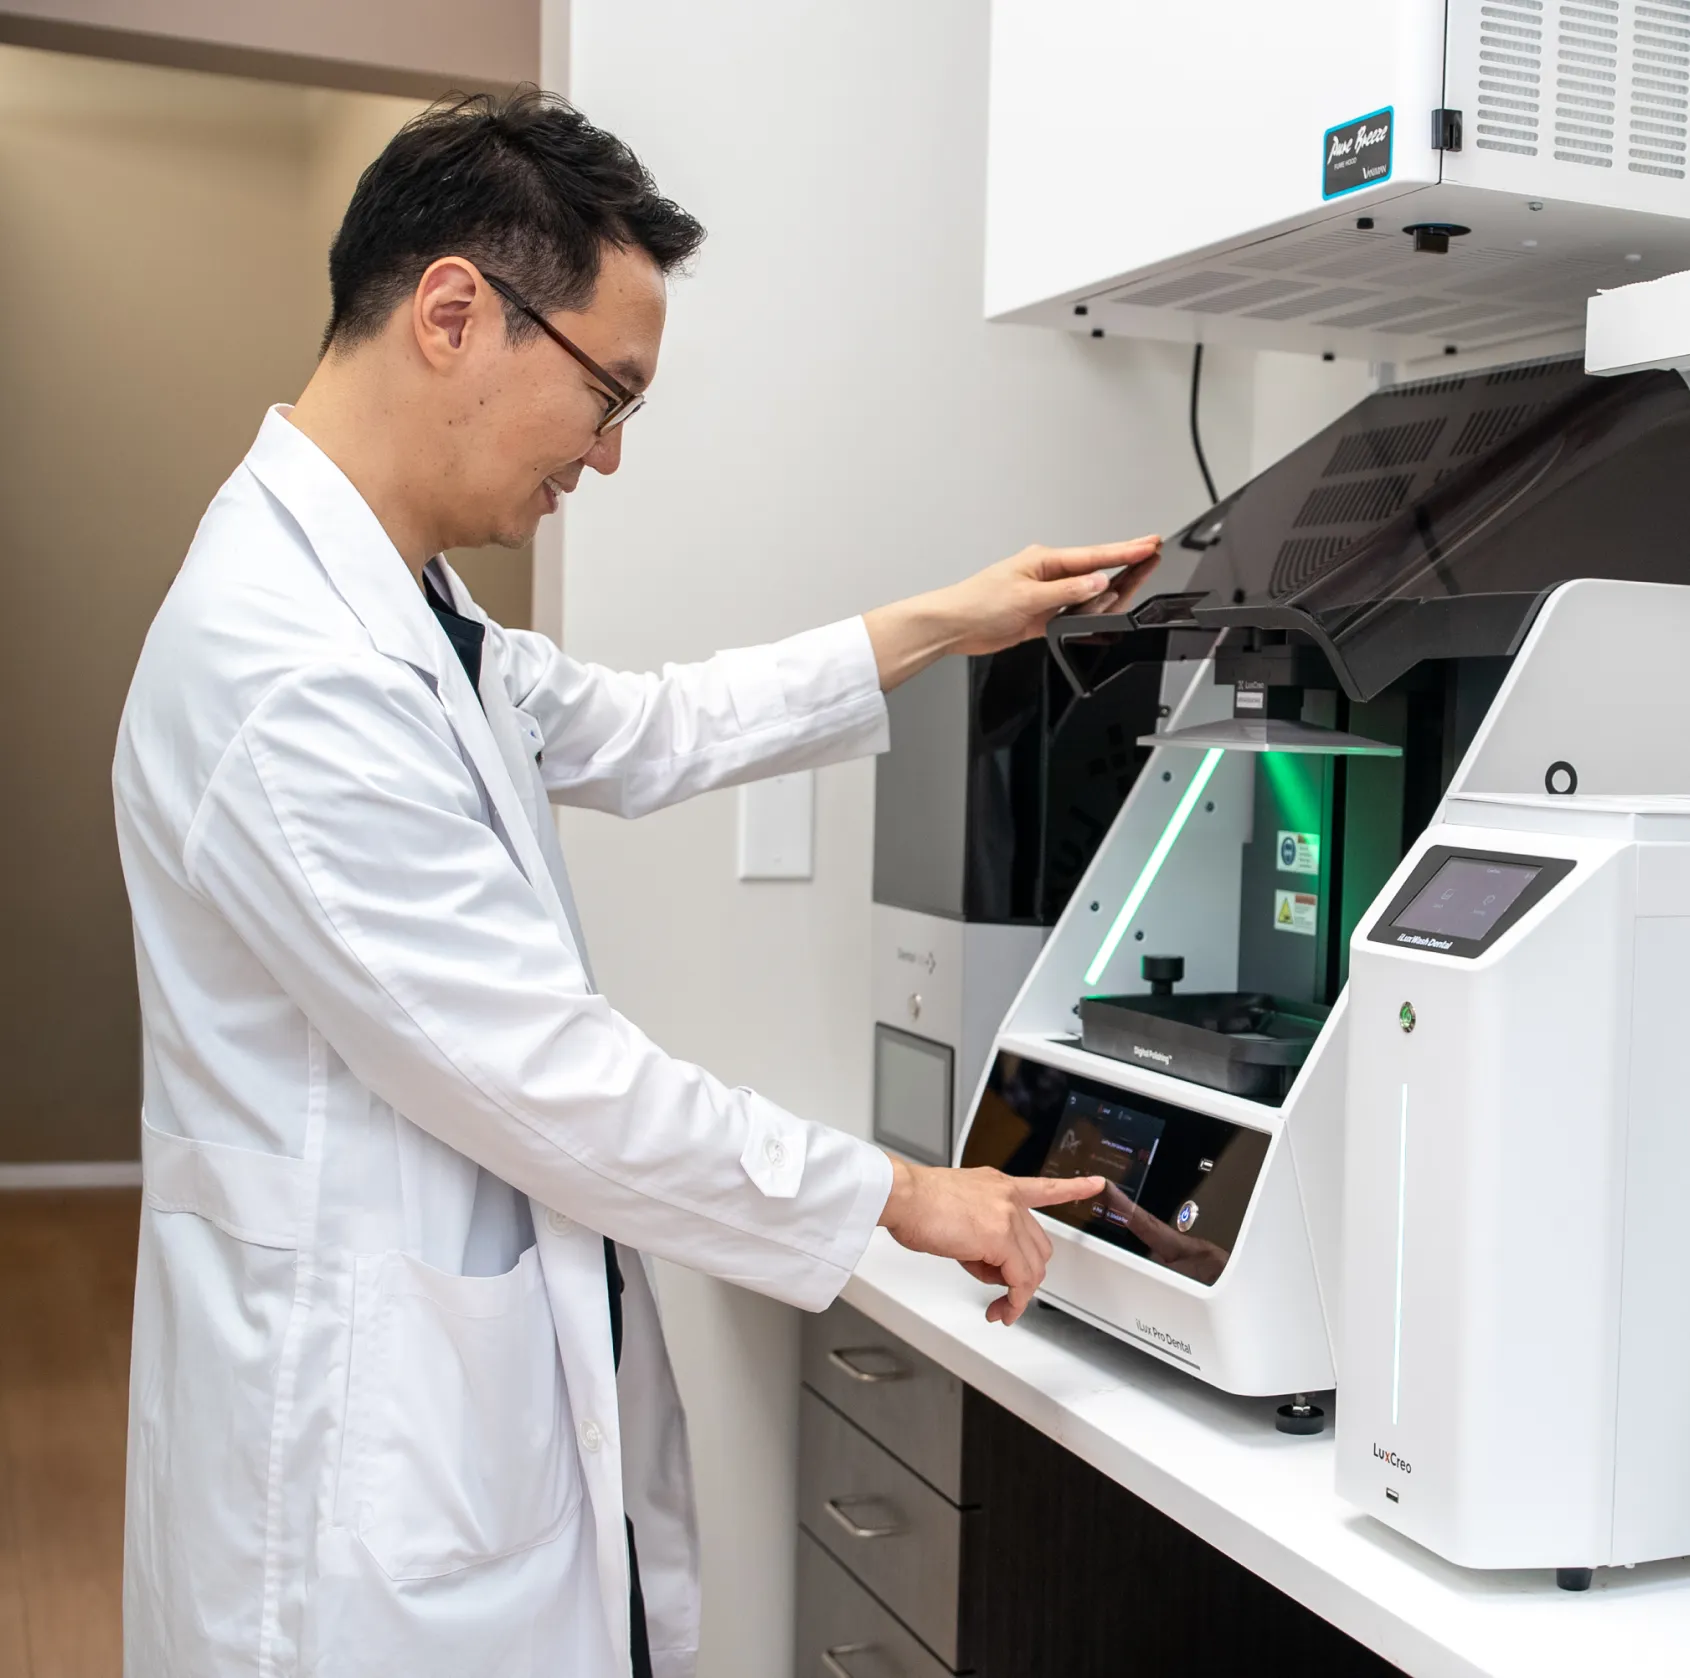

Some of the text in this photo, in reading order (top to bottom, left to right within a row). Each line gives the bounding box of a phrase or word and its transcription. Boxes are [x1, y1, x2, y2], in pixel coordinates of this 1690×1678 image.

[1327, 125, 1388, 165] Pure Breeze
[1428, 939, 1454, 950] Dental
[1152, 1326, 1166, 1342] Pro
[1165, 1333, 1192, 1355] Dental
[1373, 1442, 1412, 1474] LuxCreo
